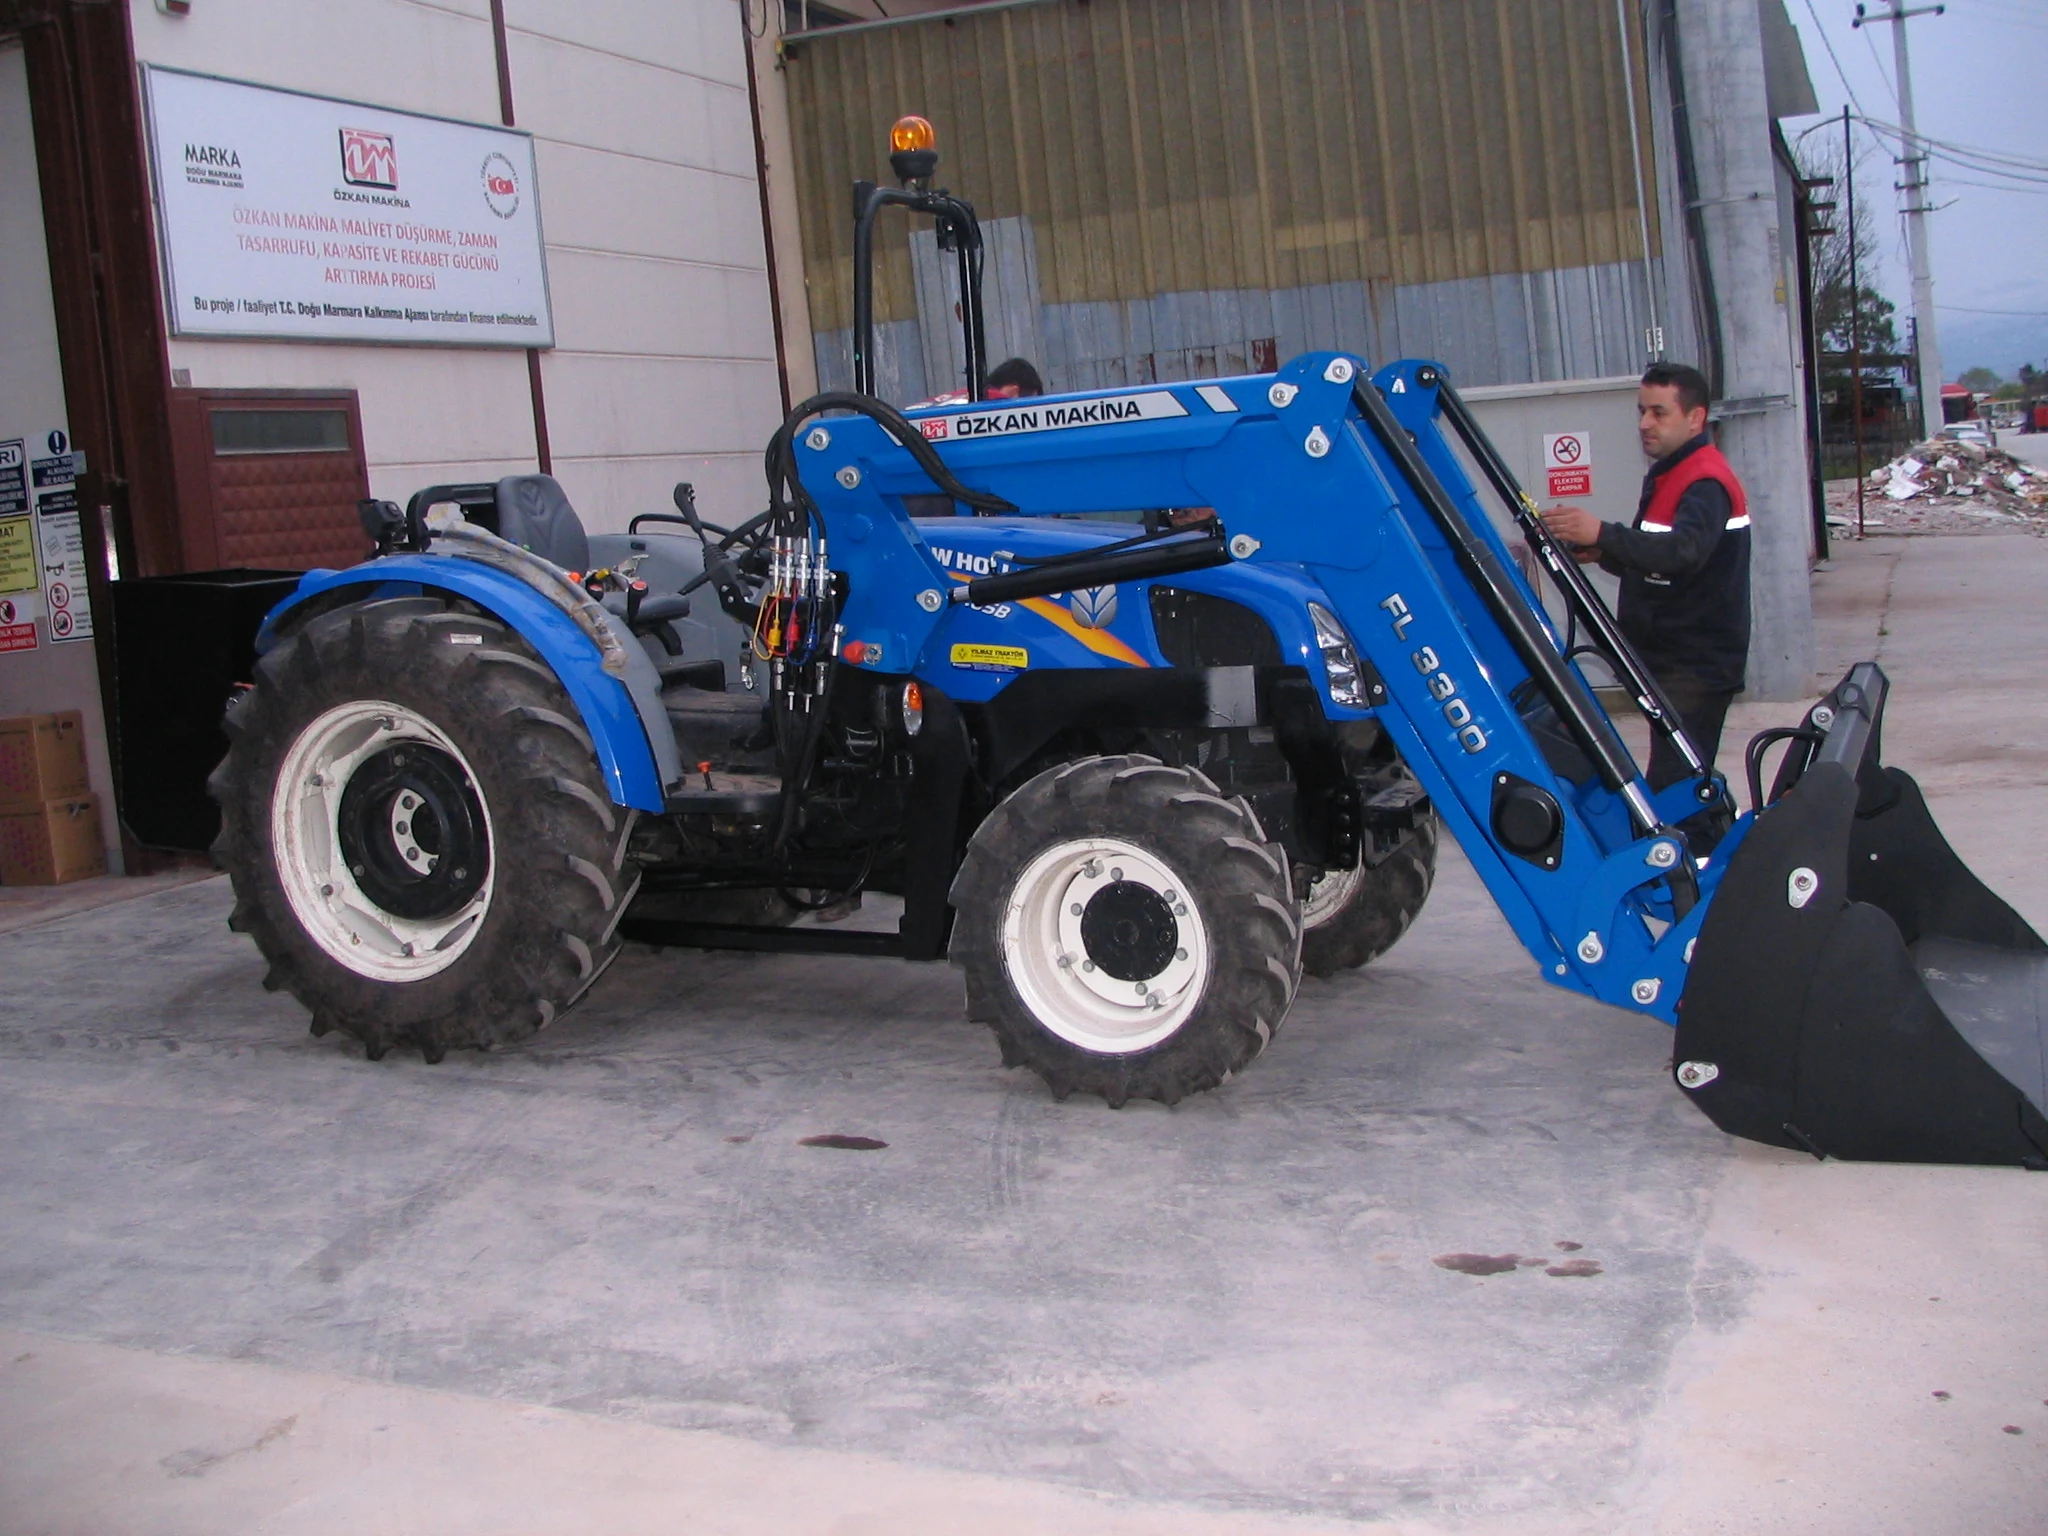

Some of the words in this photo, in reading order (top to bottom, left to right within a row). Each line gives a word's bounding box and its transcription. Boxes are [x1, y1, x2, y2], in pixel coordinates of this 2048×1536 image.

[185, 143, 241, 168] MARKA
[333, 188, 370, 204] ÖZKAN
[371, 195, 411, 208] MAKİNA
[233, 203, 280, 228] ÖZKAN
[284, 211, 338, 233] MAKİNA
[342, 217, 392, 239] MALİYET
[396, 221, 456, 247] DÜŞÜRME,
[458, 231, 497, 249] ZAMAN
[237, 234, 320, 260] TASARRUFU,
[323, 241, 380, 262] KAPASİTE
[382, 247, 398, 263] VE
[402, 249, 449, 268] REKABET
[453, 251, 499, 272] GÜCÜNÜ
[325, 266, 389, 287] ARTTIRMA
[392, 271, 436, 290] PROJESİ
[194, 296, 208, 310] Bu
[211, 299, 235, 314] proje
[244, 299, 278, 316] faaliyet
[280, 301, 296, 315] T.C.
[299, 302, 322, 318] Doğu
[323, 304, 363, 318] Marmara
[364, 306, 403, 319] Kalkınma
[957, 412, 1038, 436] ÖZKAN
[1046, 400, 1141, 428] MAKİNA
[1380, 592, 1414, 641] FL
[1411, 645, 1488, 755] 3300
